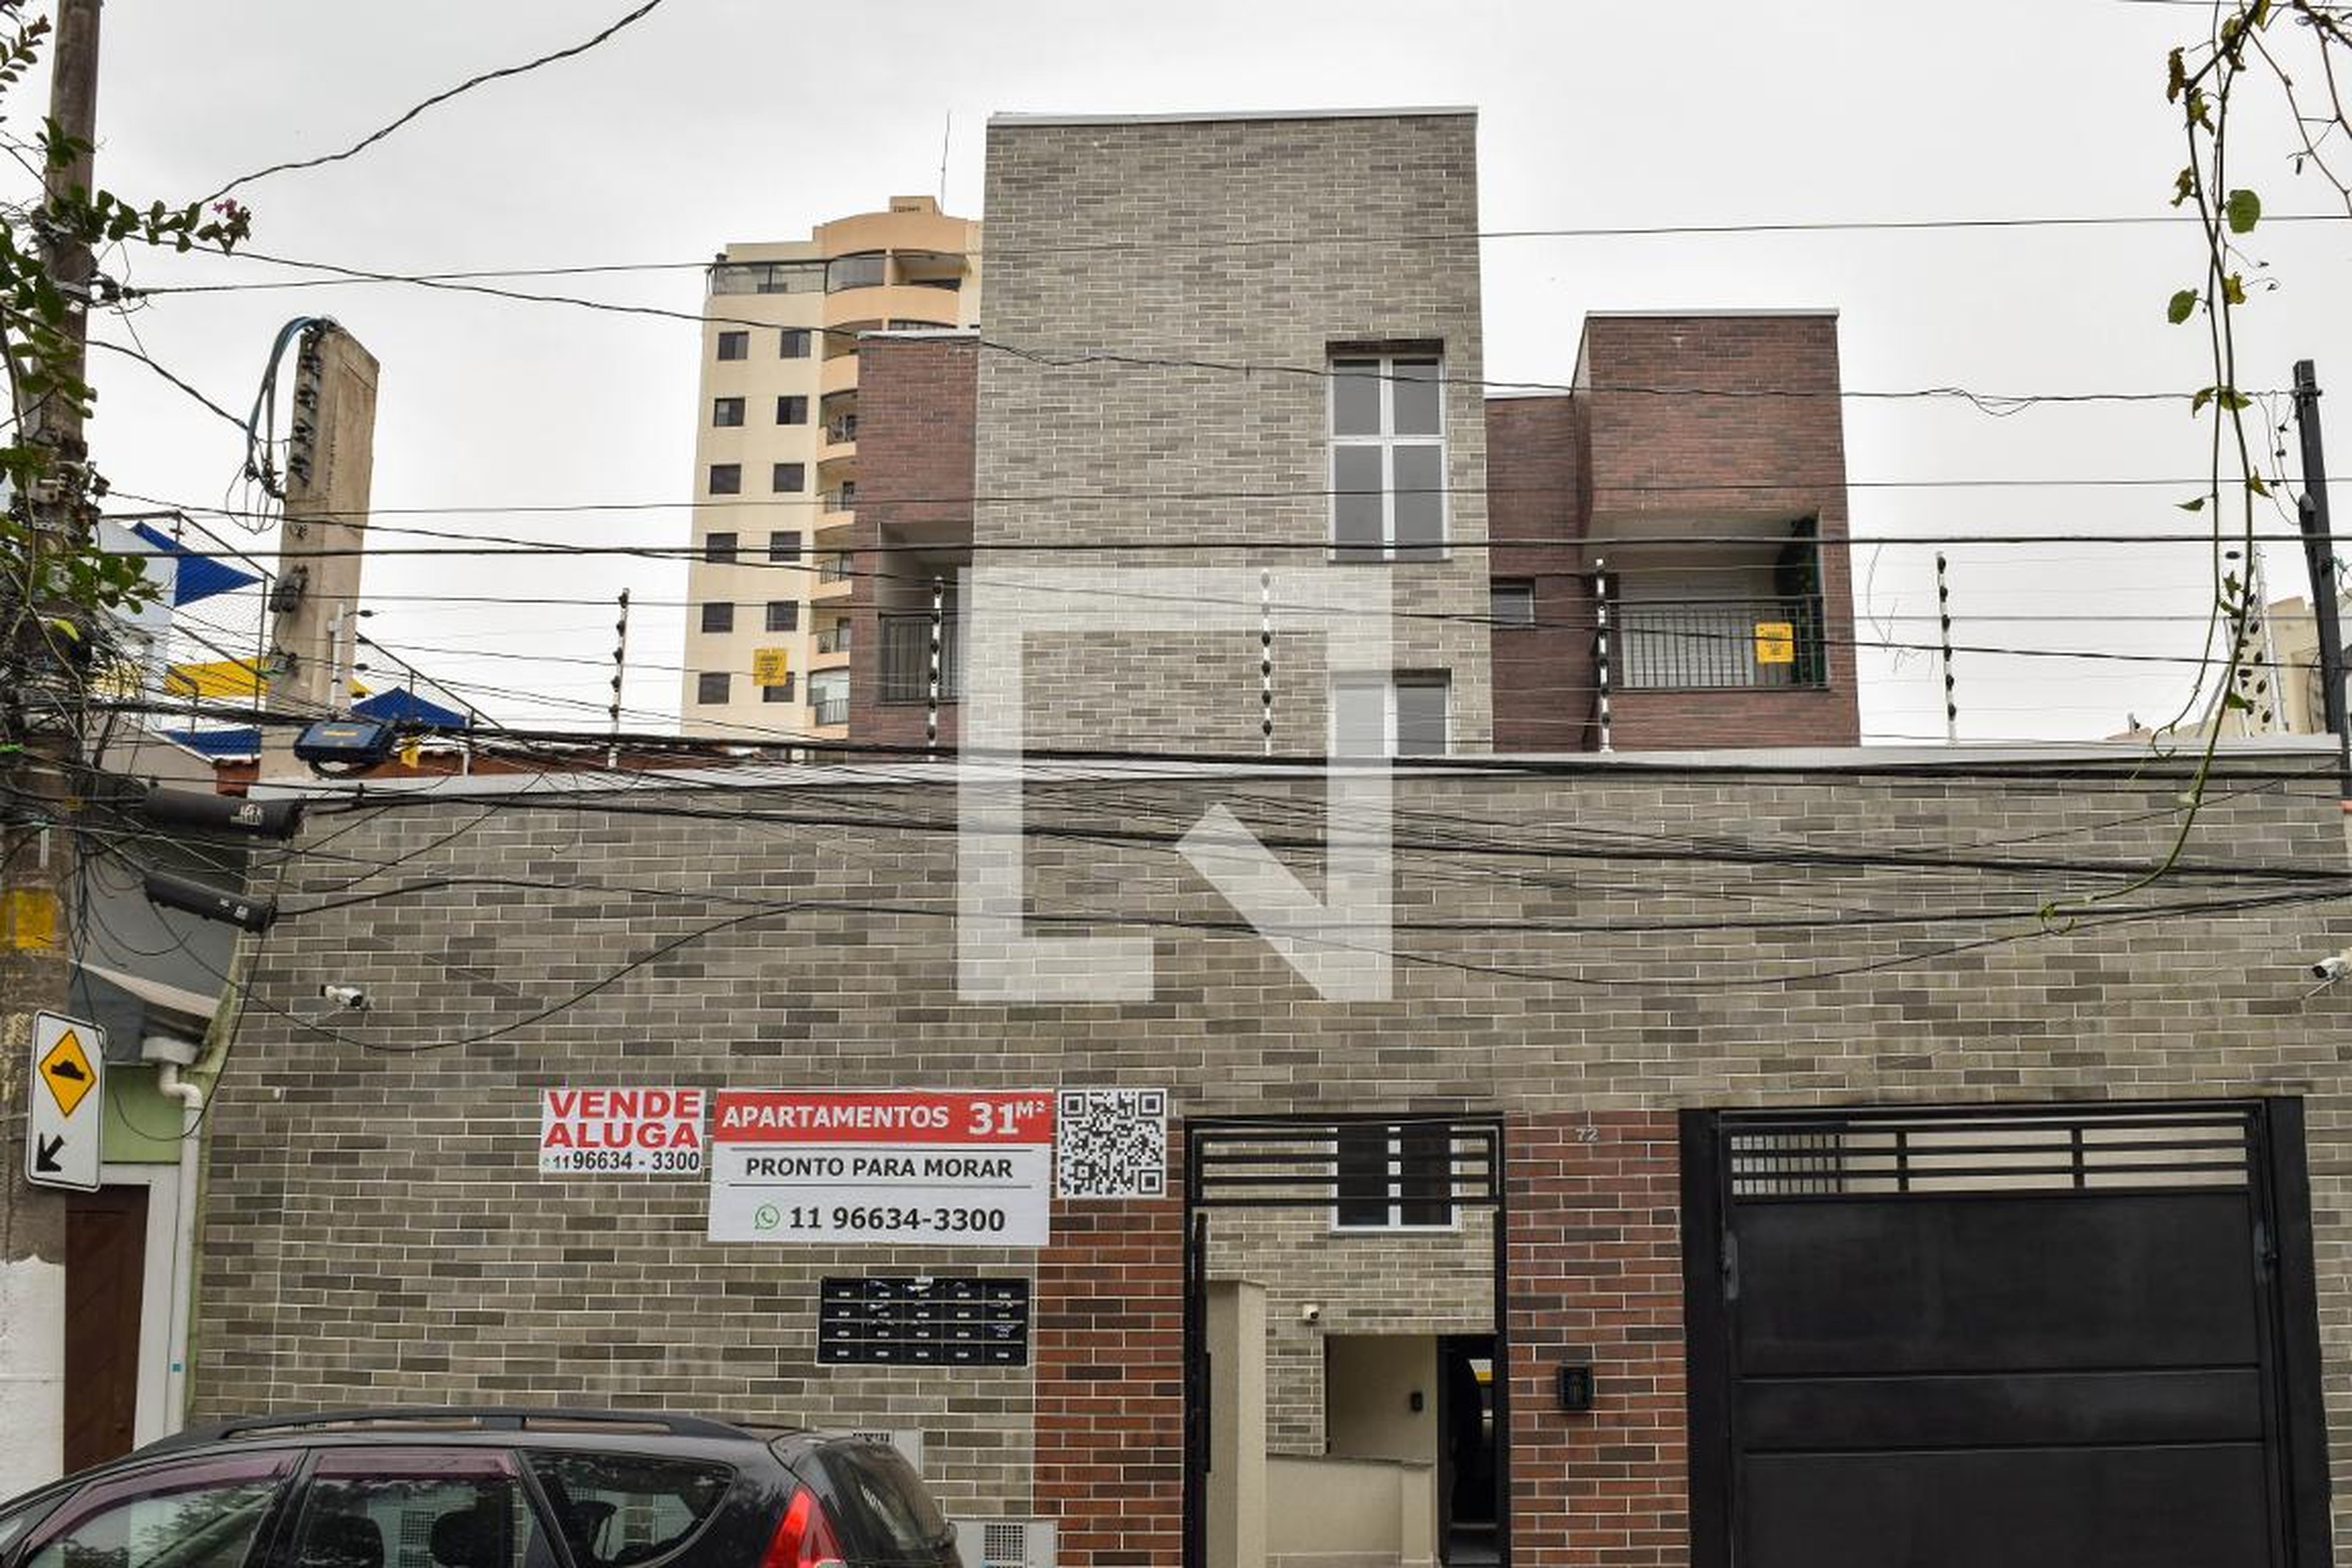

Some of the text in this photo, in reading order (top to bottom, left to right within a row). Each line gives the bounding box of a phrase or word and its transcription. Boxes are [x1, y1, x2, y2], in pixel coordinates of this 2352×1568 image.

[549, 1091, 701, 1118] VENDE
[722, 1105, 949, 1128] APARTAMENTOS
[544, 1122, 699, 1148] ALUGA
[1575, 1128, 1597, 1142] 72
[652, 1152, 699, 1170] 3300
[747, 1157, 1013, 1178] PRONTO PARA MORAR
[789, 1207, 1006, 1231] 11 96634-3300
